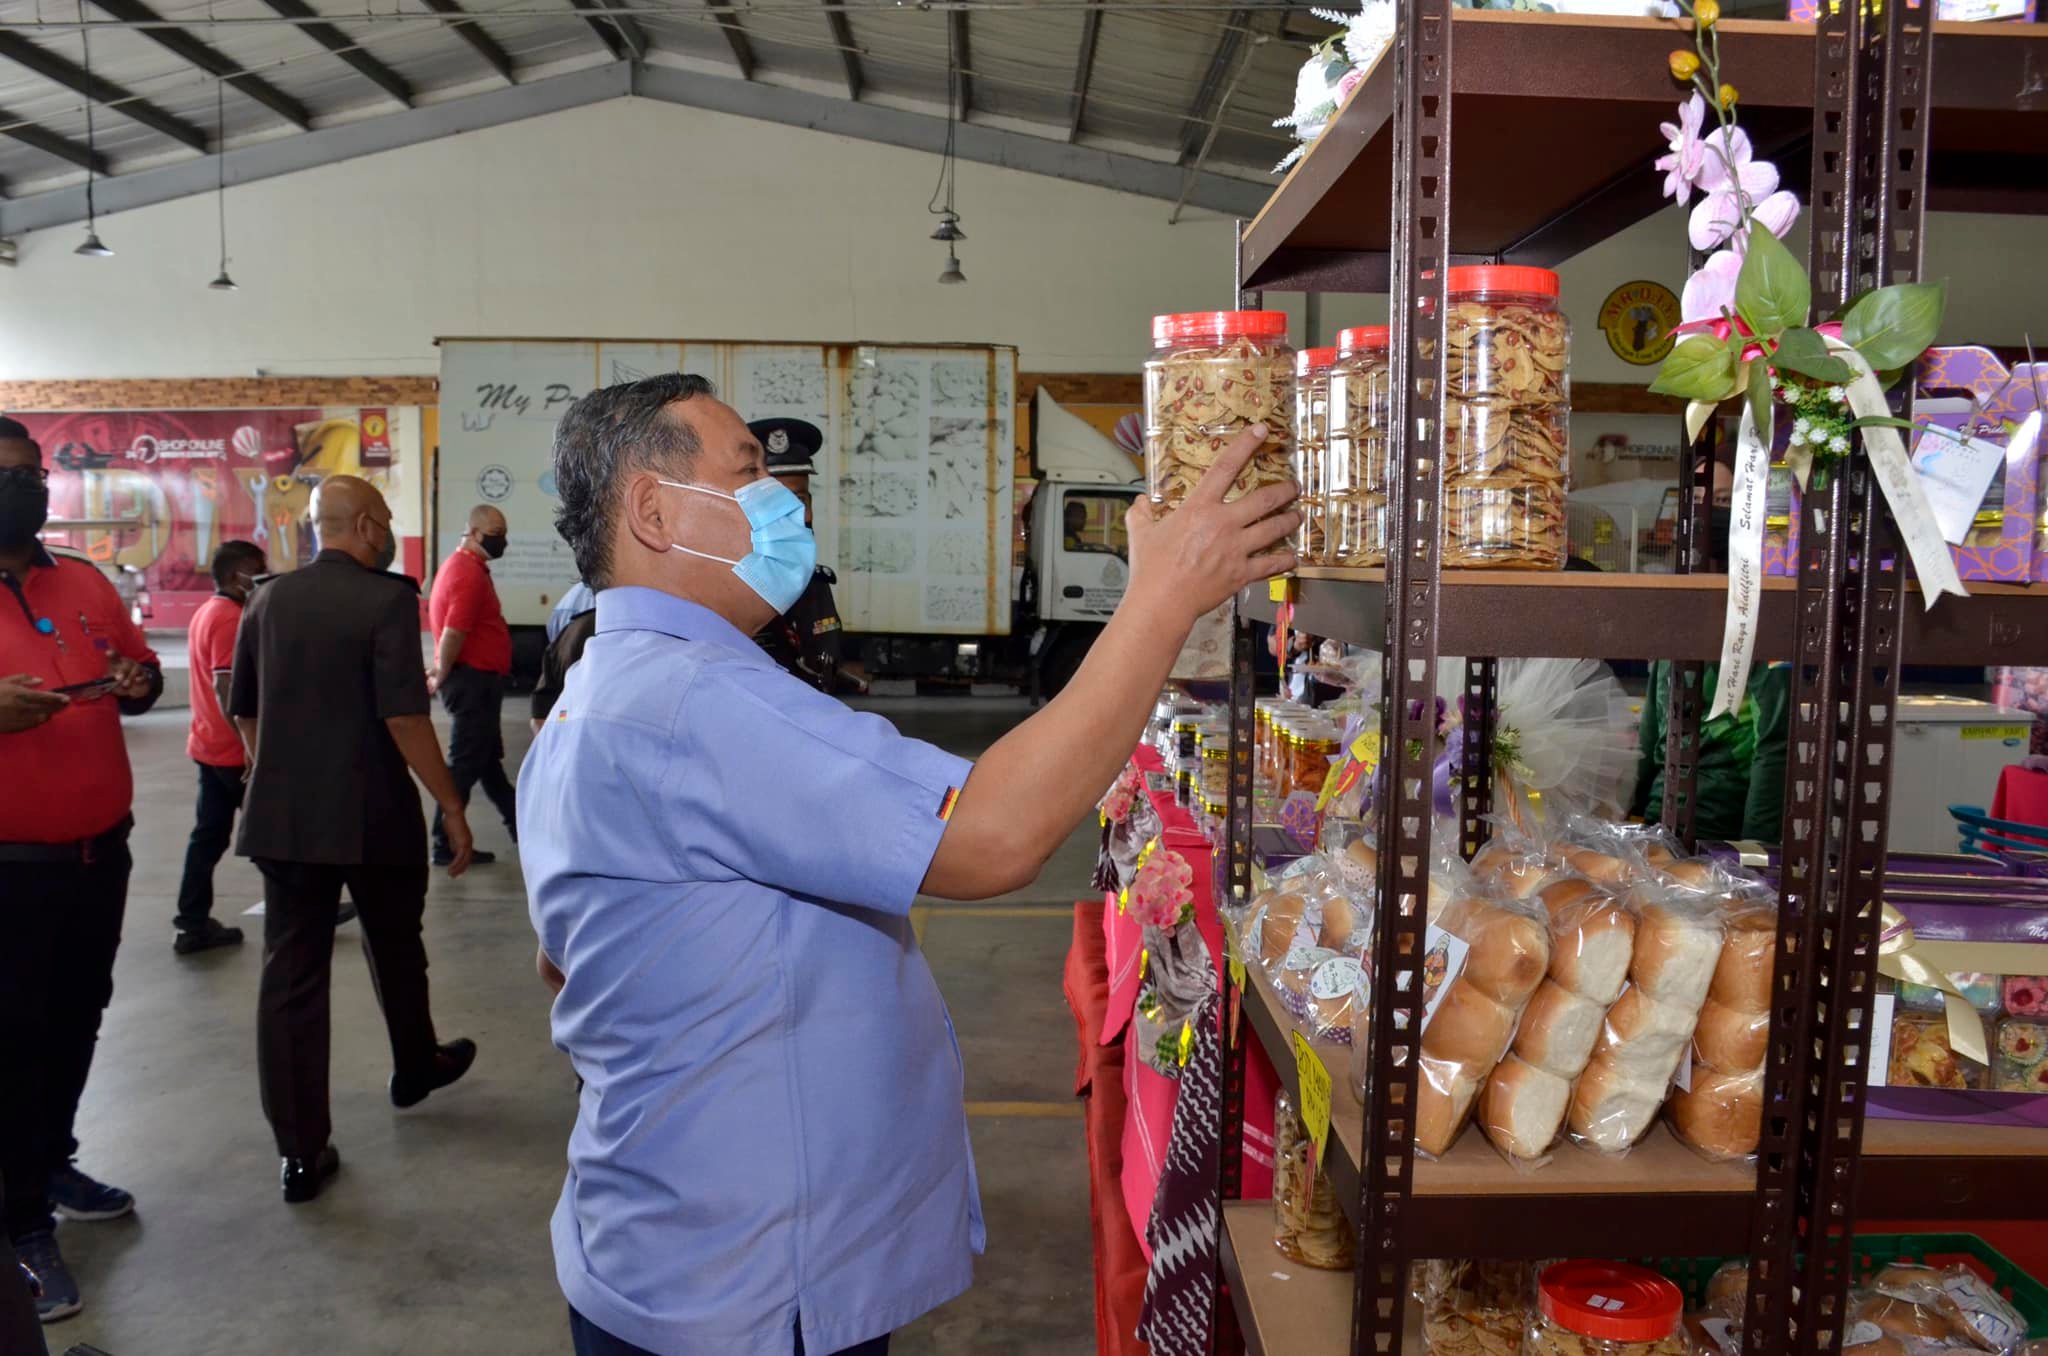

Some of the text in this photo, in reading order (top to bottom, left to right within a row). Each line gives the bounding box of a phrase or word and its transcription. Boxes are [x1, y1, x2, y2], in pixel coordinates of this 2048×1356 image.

[476, 383, 530, 416] My
[158, 439, 225, 451] SHOP ONLINE
[1745, 440, 1759, 474] Hari
[1740, 477, 1755, 530] Selamat
[1731, 621, 1748, 656] Raya
[1726, 659, 1742, 689] Hari
